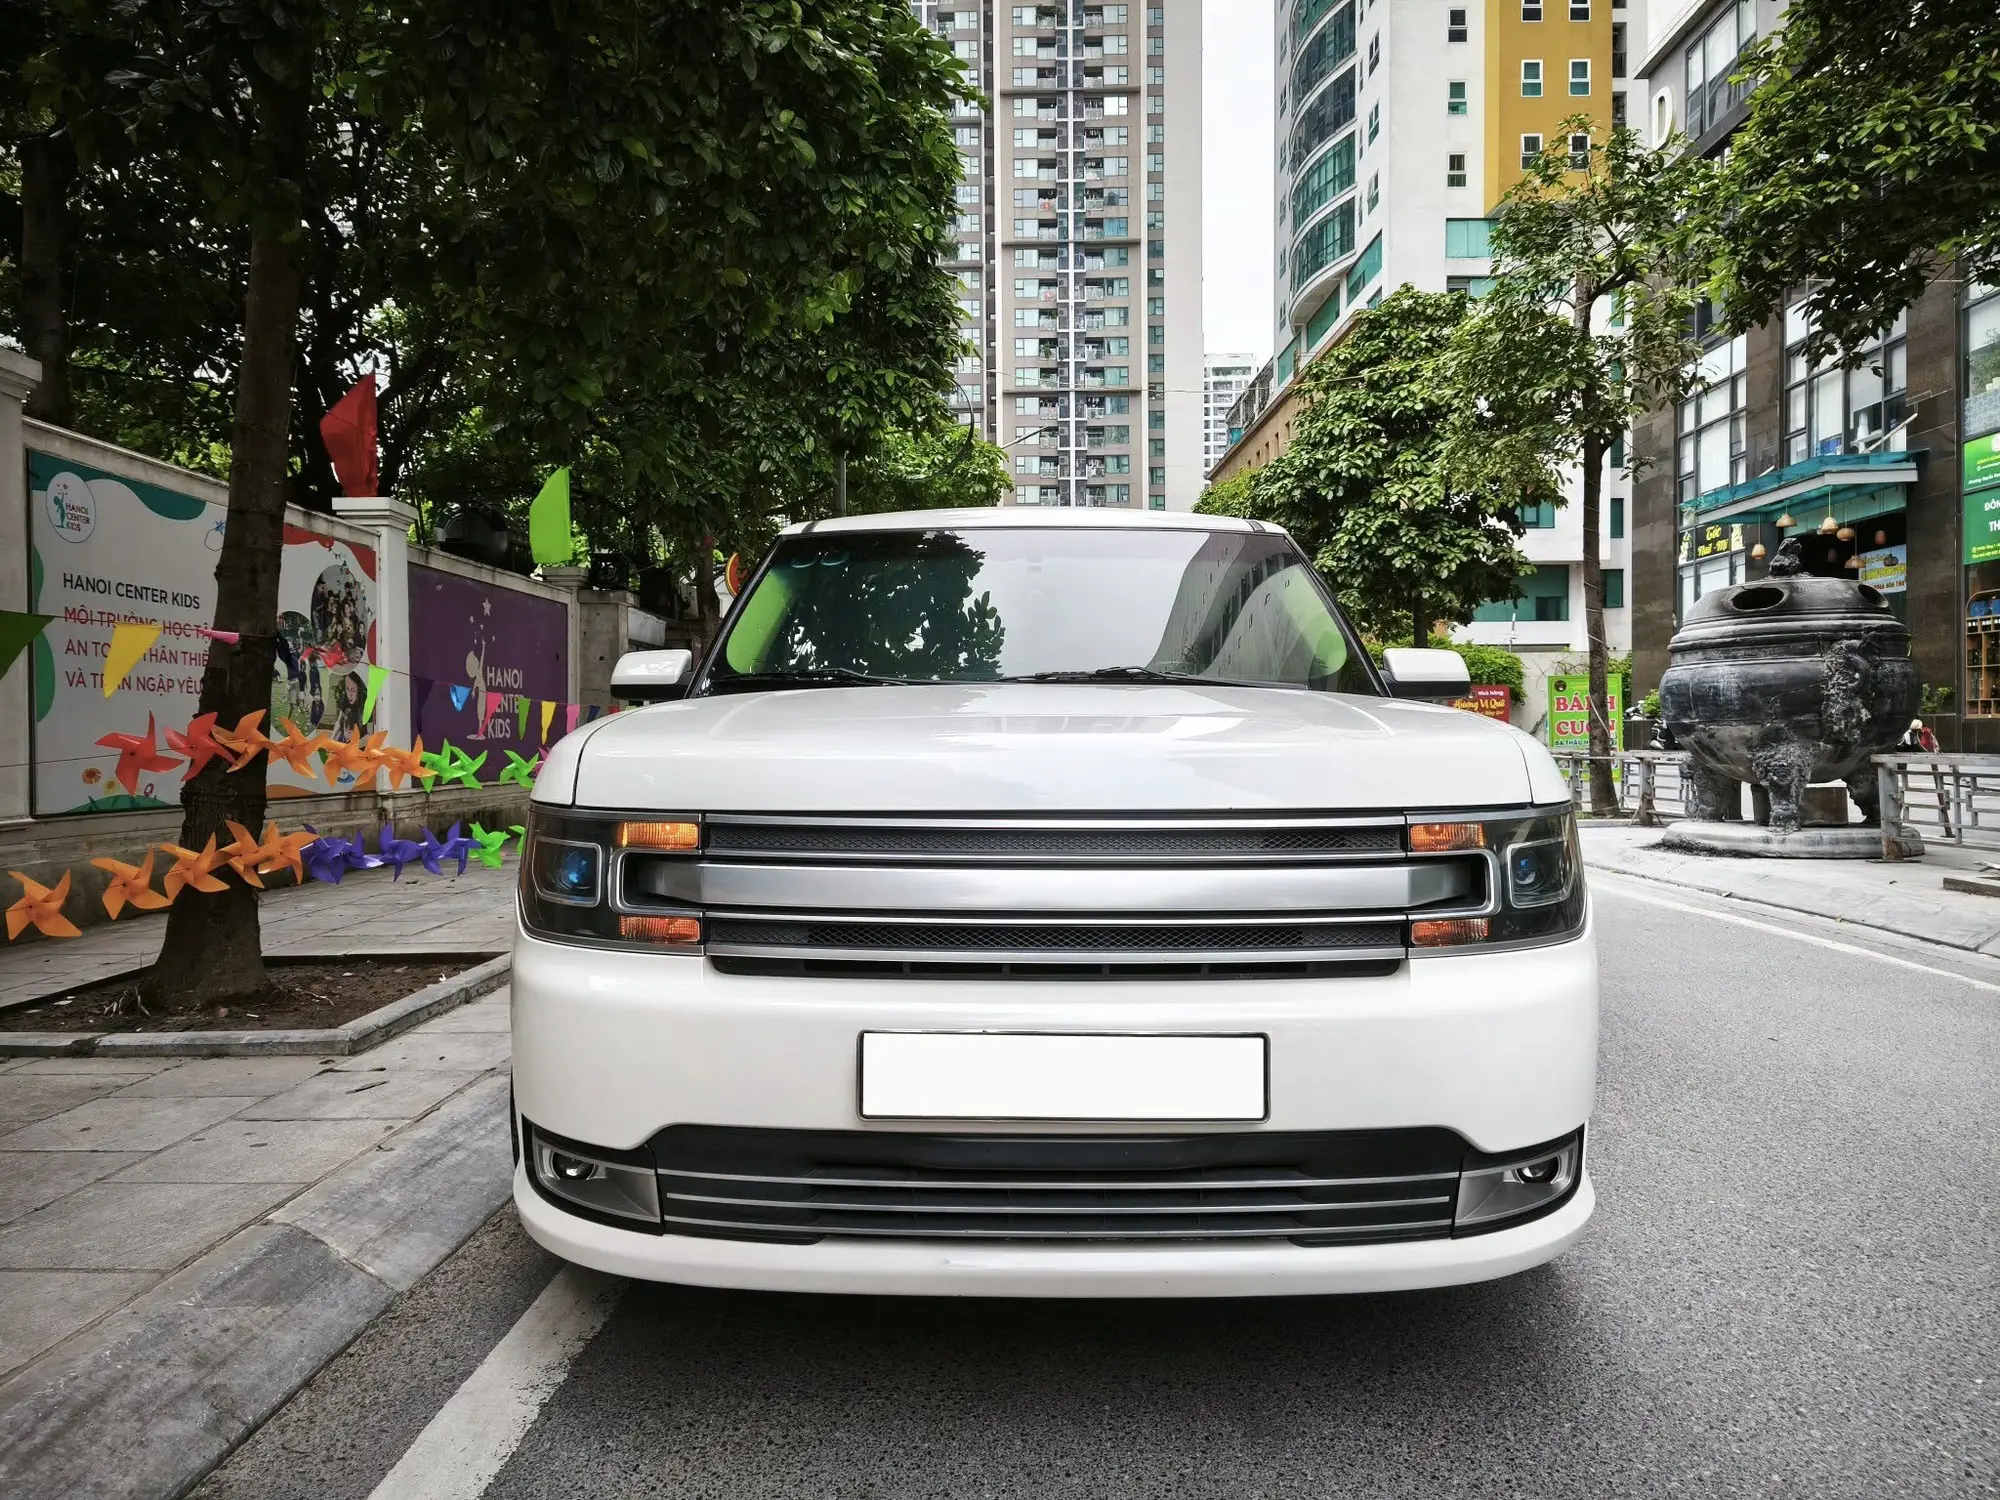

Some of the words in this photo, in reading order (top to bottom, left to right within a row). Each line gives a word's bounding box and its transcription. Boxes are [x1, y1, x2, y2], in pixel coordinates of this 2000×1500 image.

[65, 502, 89, 515] HANOI
[66, 512, 91, 525] CENTER
[63, 572, 112, 596] HANOI
[115, 582, 168, 605] CENTER
[171, 591, 201, 610] KIDS
[64, 604, 93, 626] MÔI
[162, 620, 192, 641] HỌC
[194, 622, 212, 644] TẬ
[64, 638, 88, 657] AN
[92, 641, 111, 659] TO
[64, 667, 87, 688] VÀ
[90, 672, 132, 691] TN
[136, 673, 175, 697] NGẬP
[177, 676, 204, 695] YÊU
[486, 666, 523, 689] HANOI
[495, 693, 525, 714] NTE
[487, 718, 511, 739] KIDS
